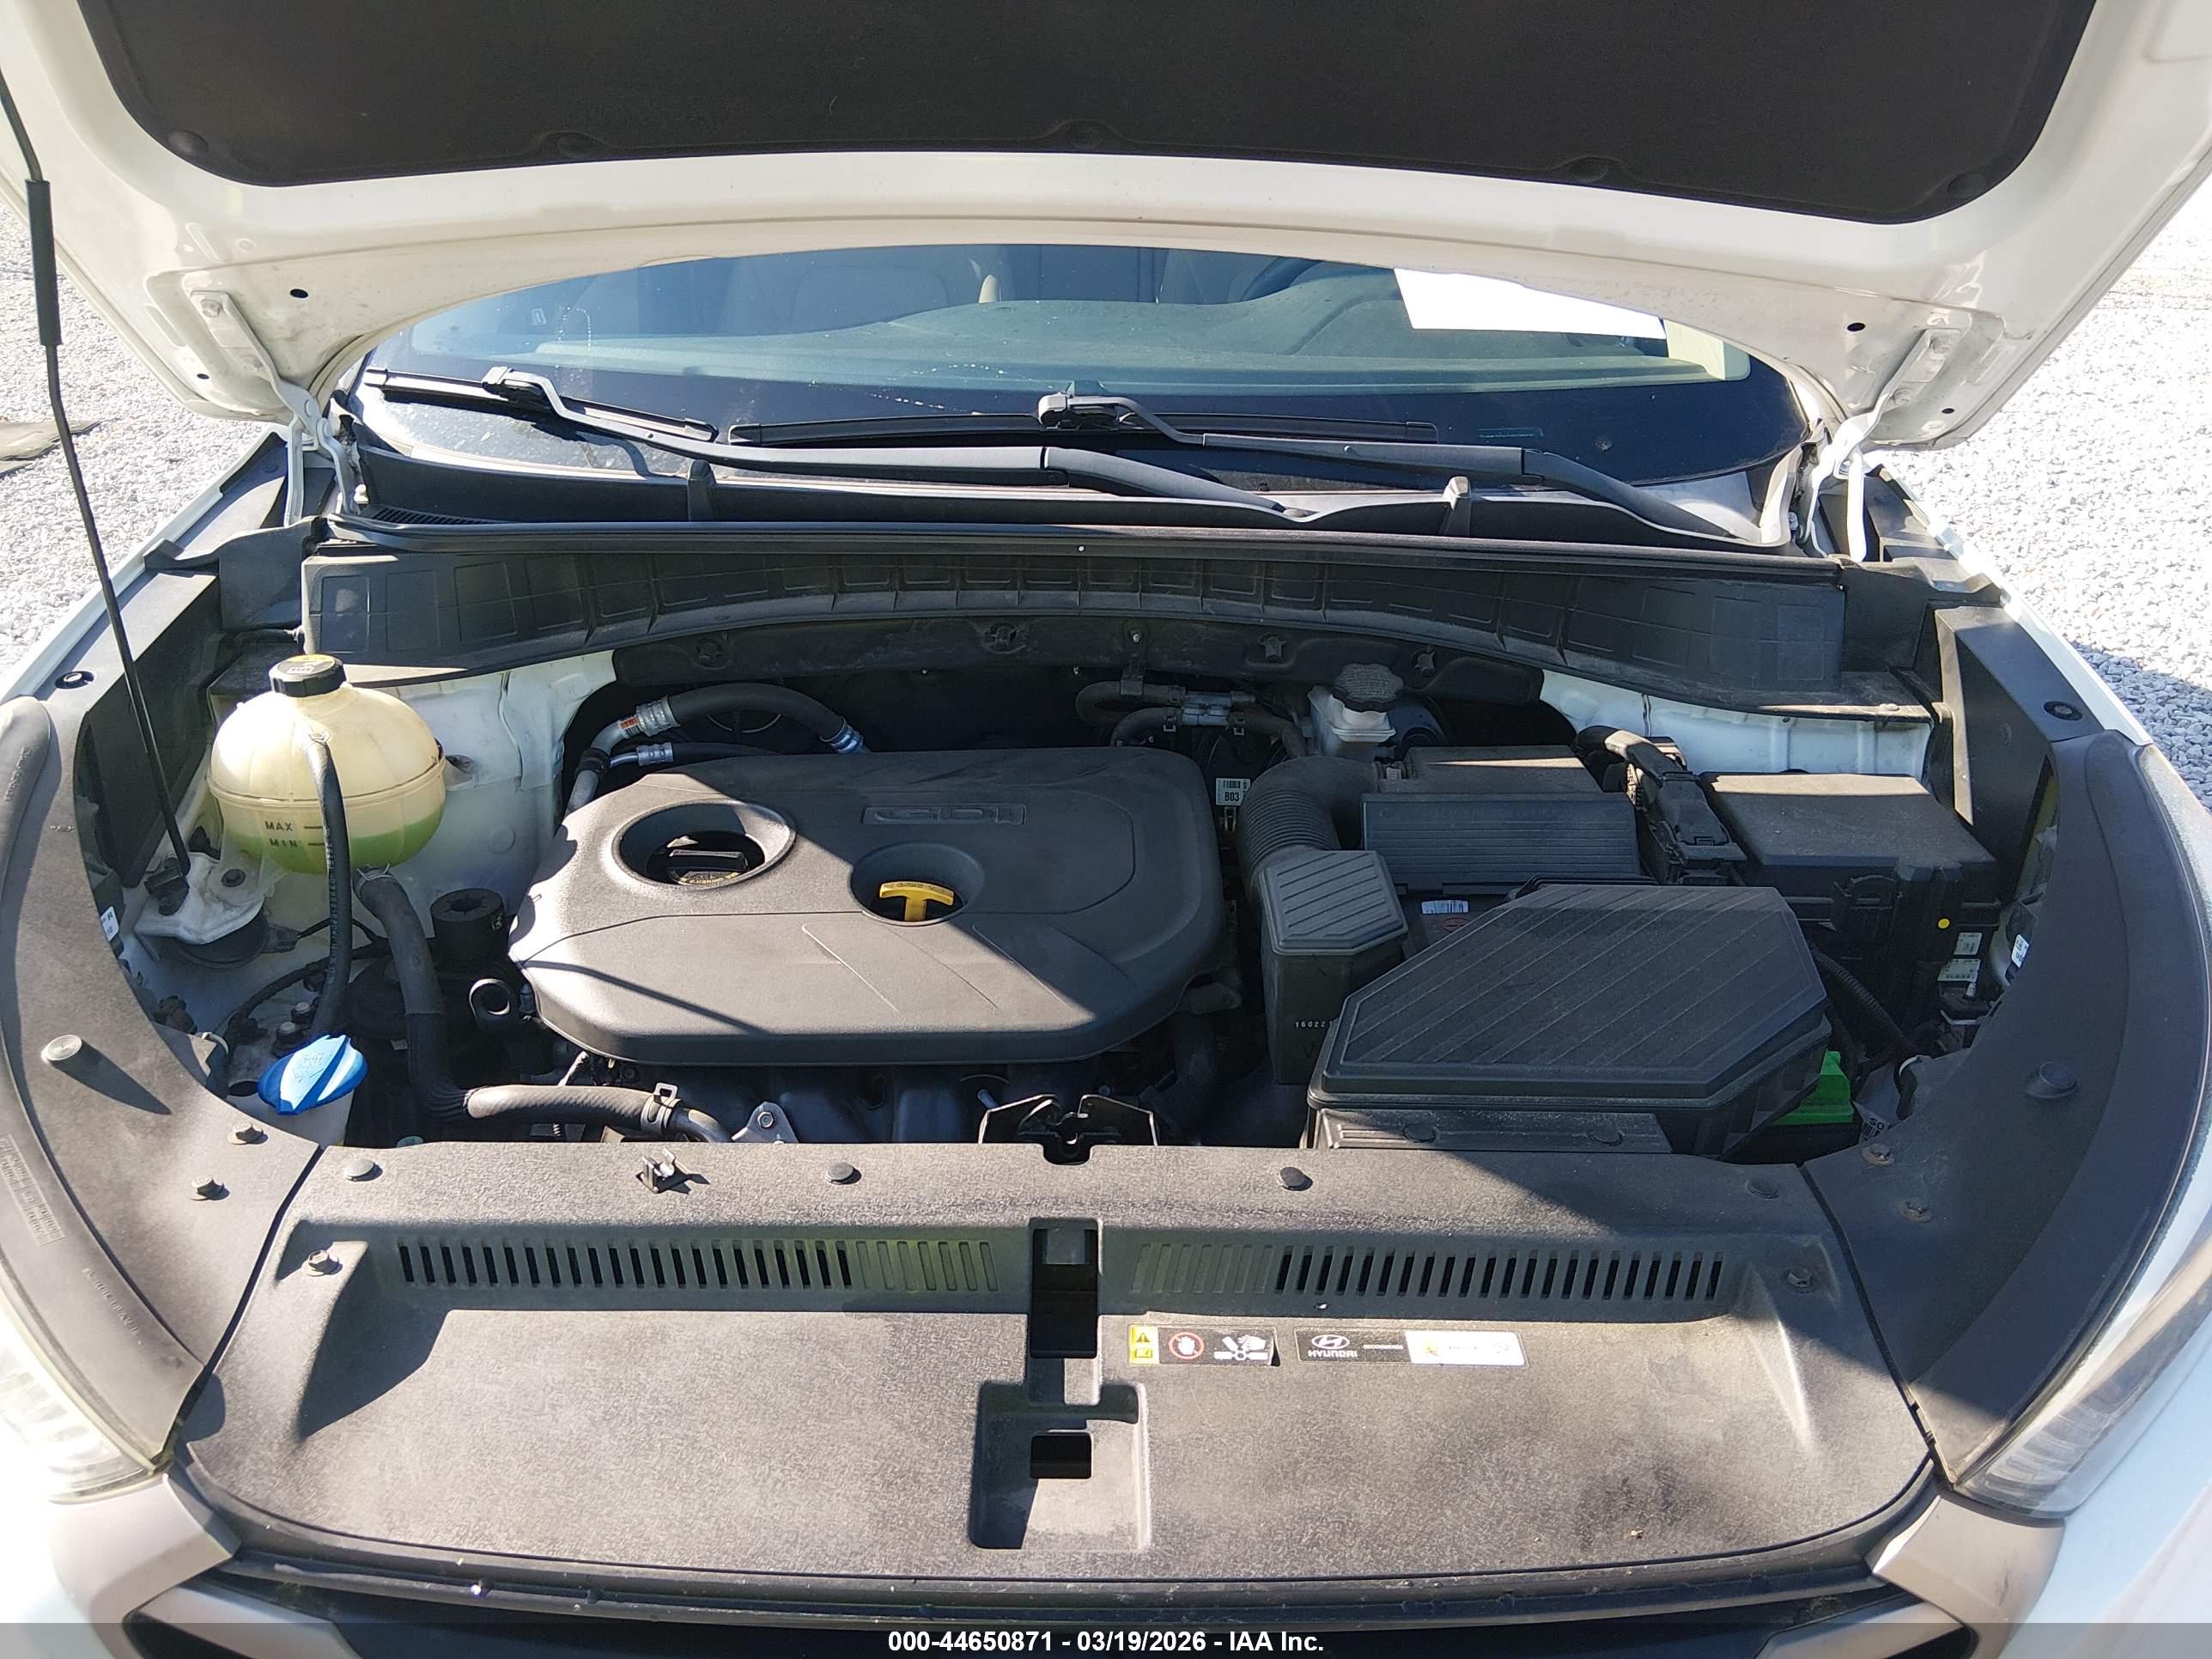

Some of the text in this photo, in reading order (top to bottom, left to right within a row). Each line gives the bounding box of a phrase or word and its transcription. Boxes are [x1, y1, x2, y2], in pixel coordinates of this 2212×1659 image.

[1224, 791, 1240, 802] B03
[264, 821, 294, 832] MAX
[269, 837, 298, 848] MIN
[1308, 1349, 1358, 1358] HYUNDAI
